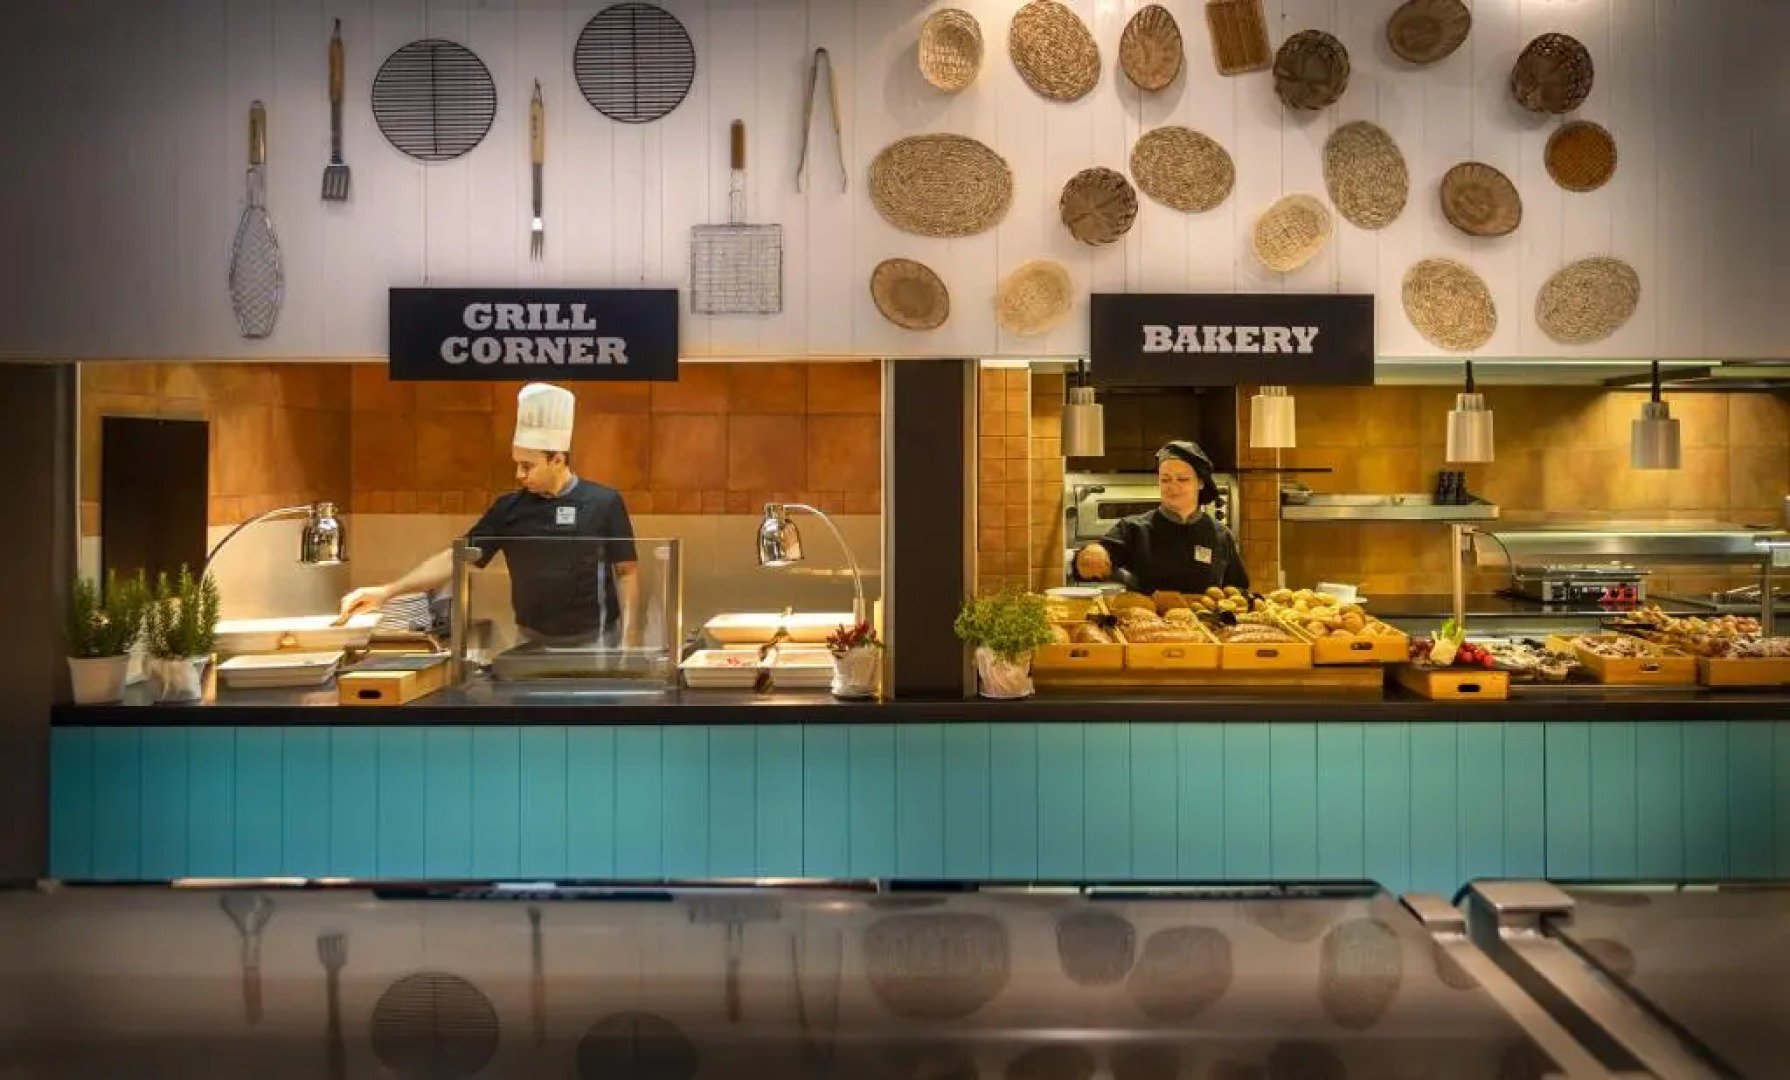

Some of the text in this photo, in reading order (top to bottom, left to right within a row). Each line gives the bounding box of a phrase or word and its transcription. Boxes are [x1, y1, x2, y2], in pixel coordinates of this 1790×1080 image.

[463, 303, 597, 331] GRILL
[440, 336, 629, 365] CORNER
[1142, 324, 1320, 354] BAKERY
